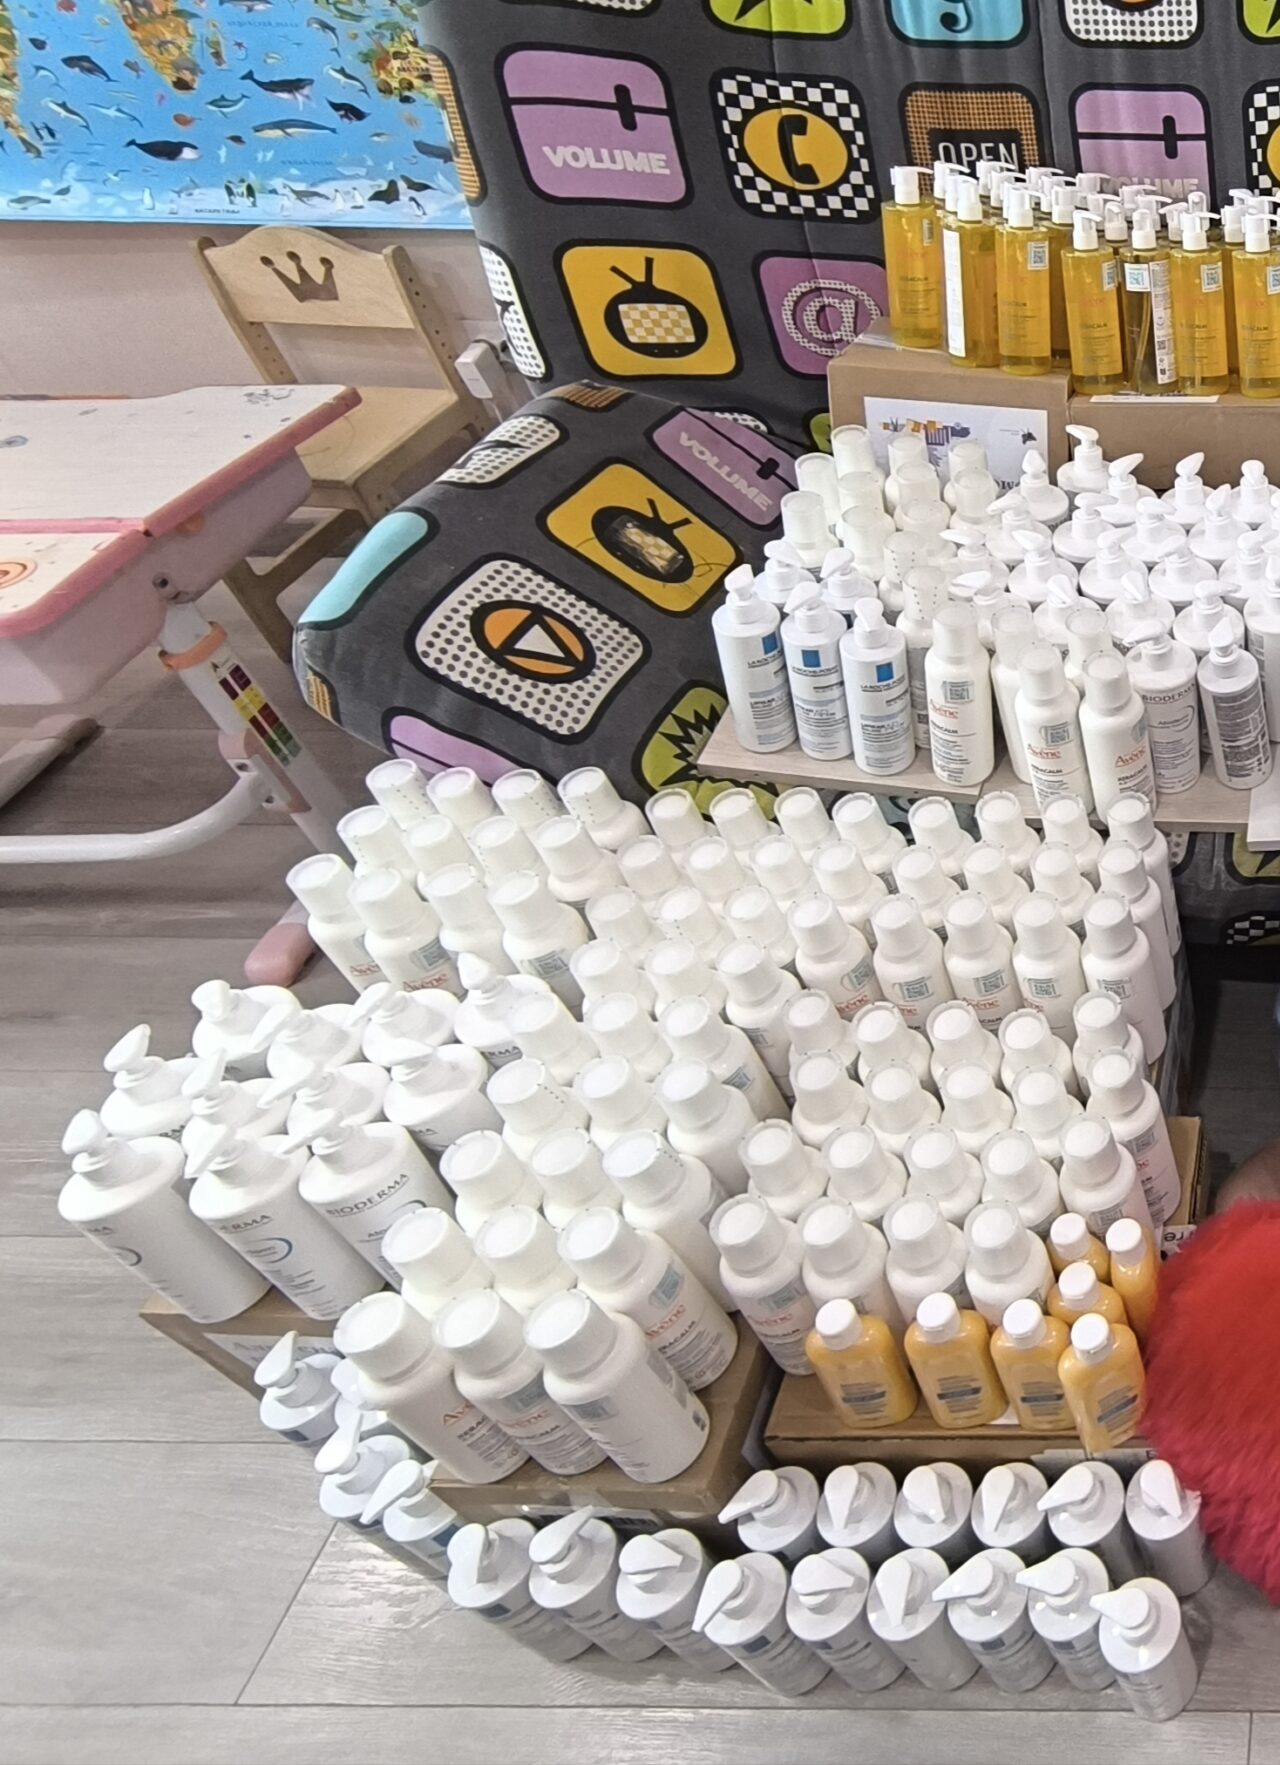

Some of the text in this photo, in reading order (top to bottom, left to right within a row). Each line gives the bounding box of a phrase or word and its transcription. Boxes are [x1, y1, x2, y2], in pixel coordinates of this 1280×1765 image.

[541, 145, 671, 175] VOLUME
[680, 432, 773, 511] VOLUME
[327, 1174, 408, 1217] BIODERMA
